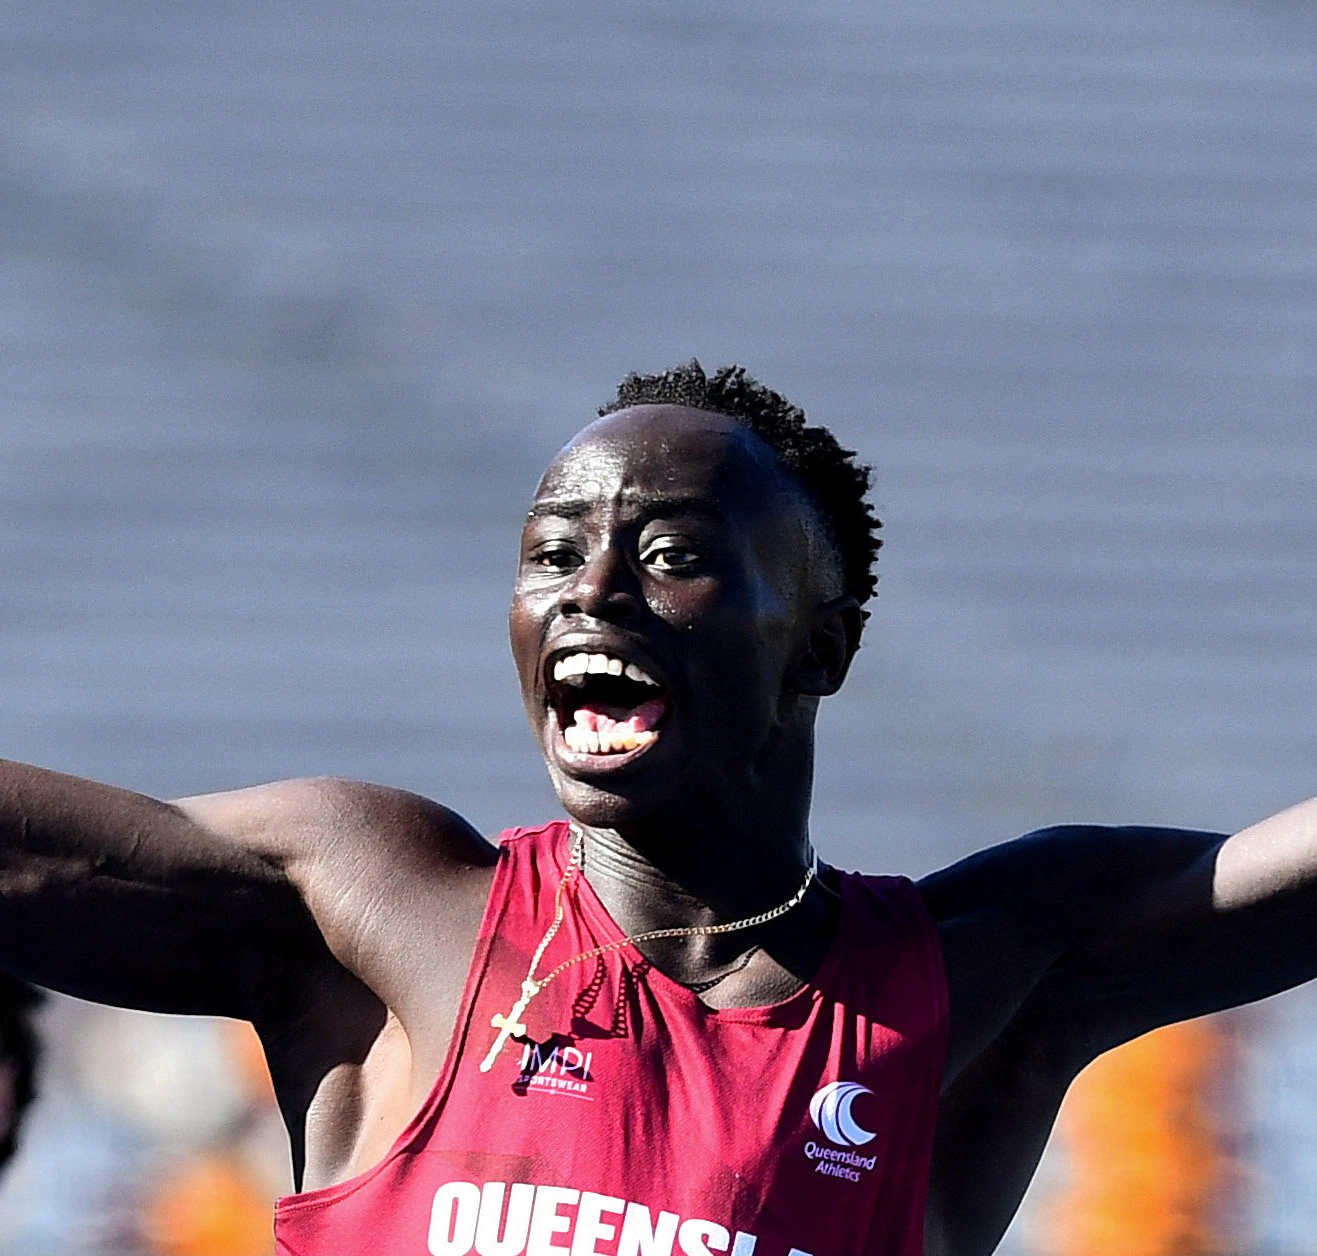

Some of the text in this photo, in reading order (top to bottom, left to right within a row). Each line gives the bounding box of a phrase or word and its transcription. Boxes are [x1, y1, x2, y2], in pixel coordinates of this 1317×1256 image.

[520, 1043, 593, 1080] IMPI
[804, 1141, 877, 1171] Queensland
[815, 1160, 860, 1182] Athletics
